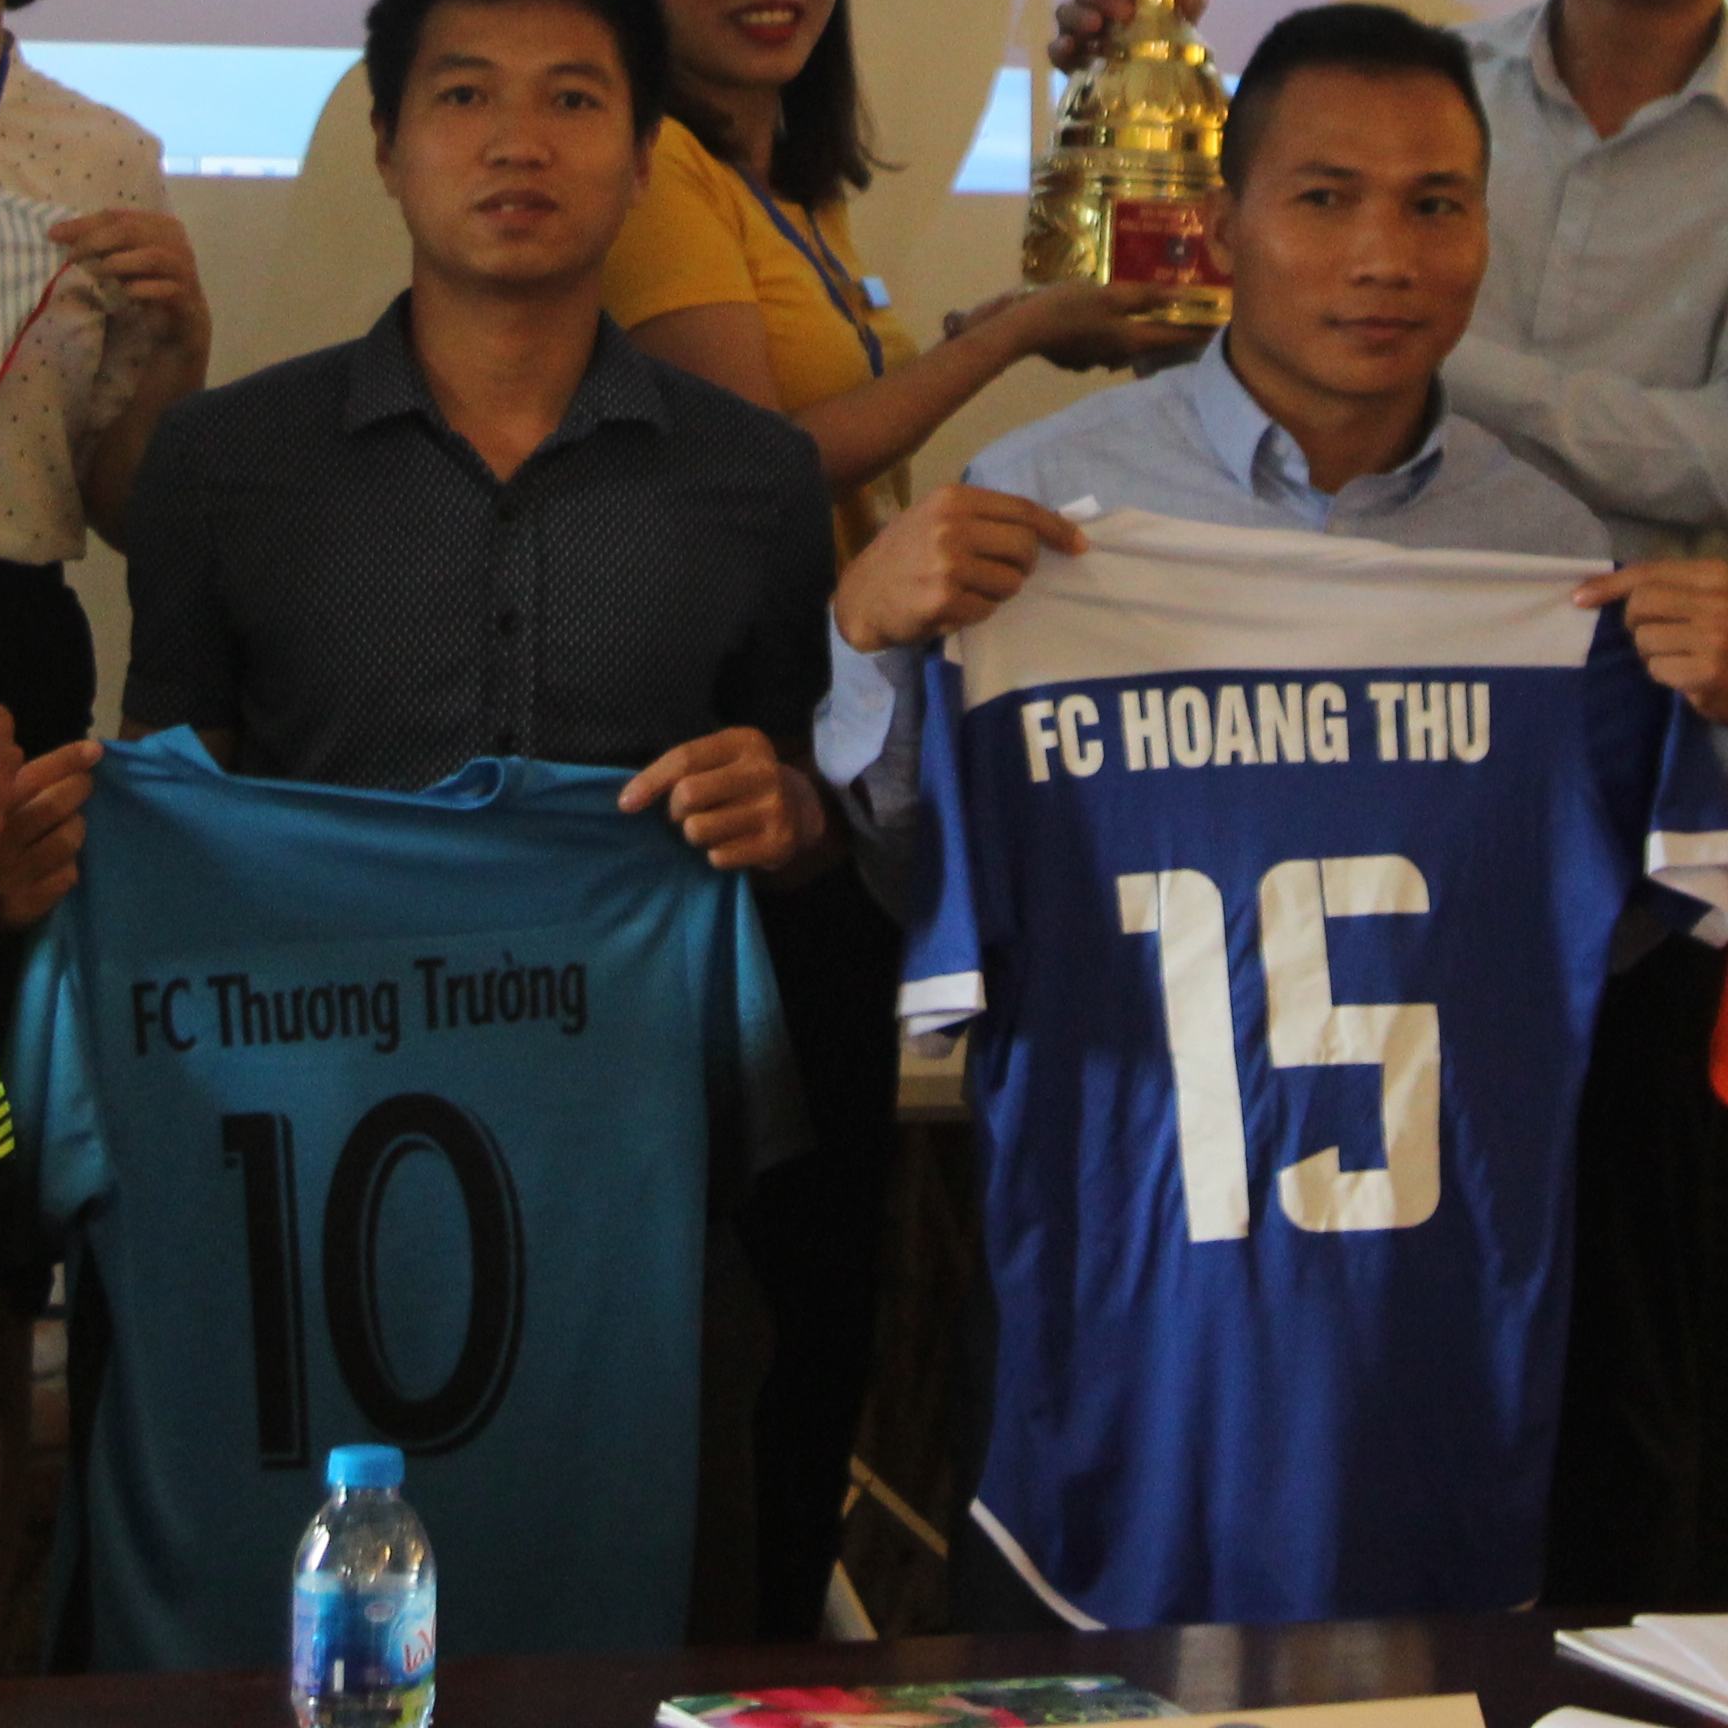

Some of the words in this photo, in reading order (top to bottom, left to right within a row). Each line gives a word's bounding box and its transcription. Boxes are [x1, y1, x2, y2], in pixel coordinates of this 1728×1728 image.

[1021, 695, 1104, 783] FC
[1119, 683, 1349, 771] HOANG
[1370, 681, 1491, 765] THU
[131, 978, 197, 1057] FC
[1118, 854, 1442, 1242] 15
[222, 1092, 527, 1472] 10
